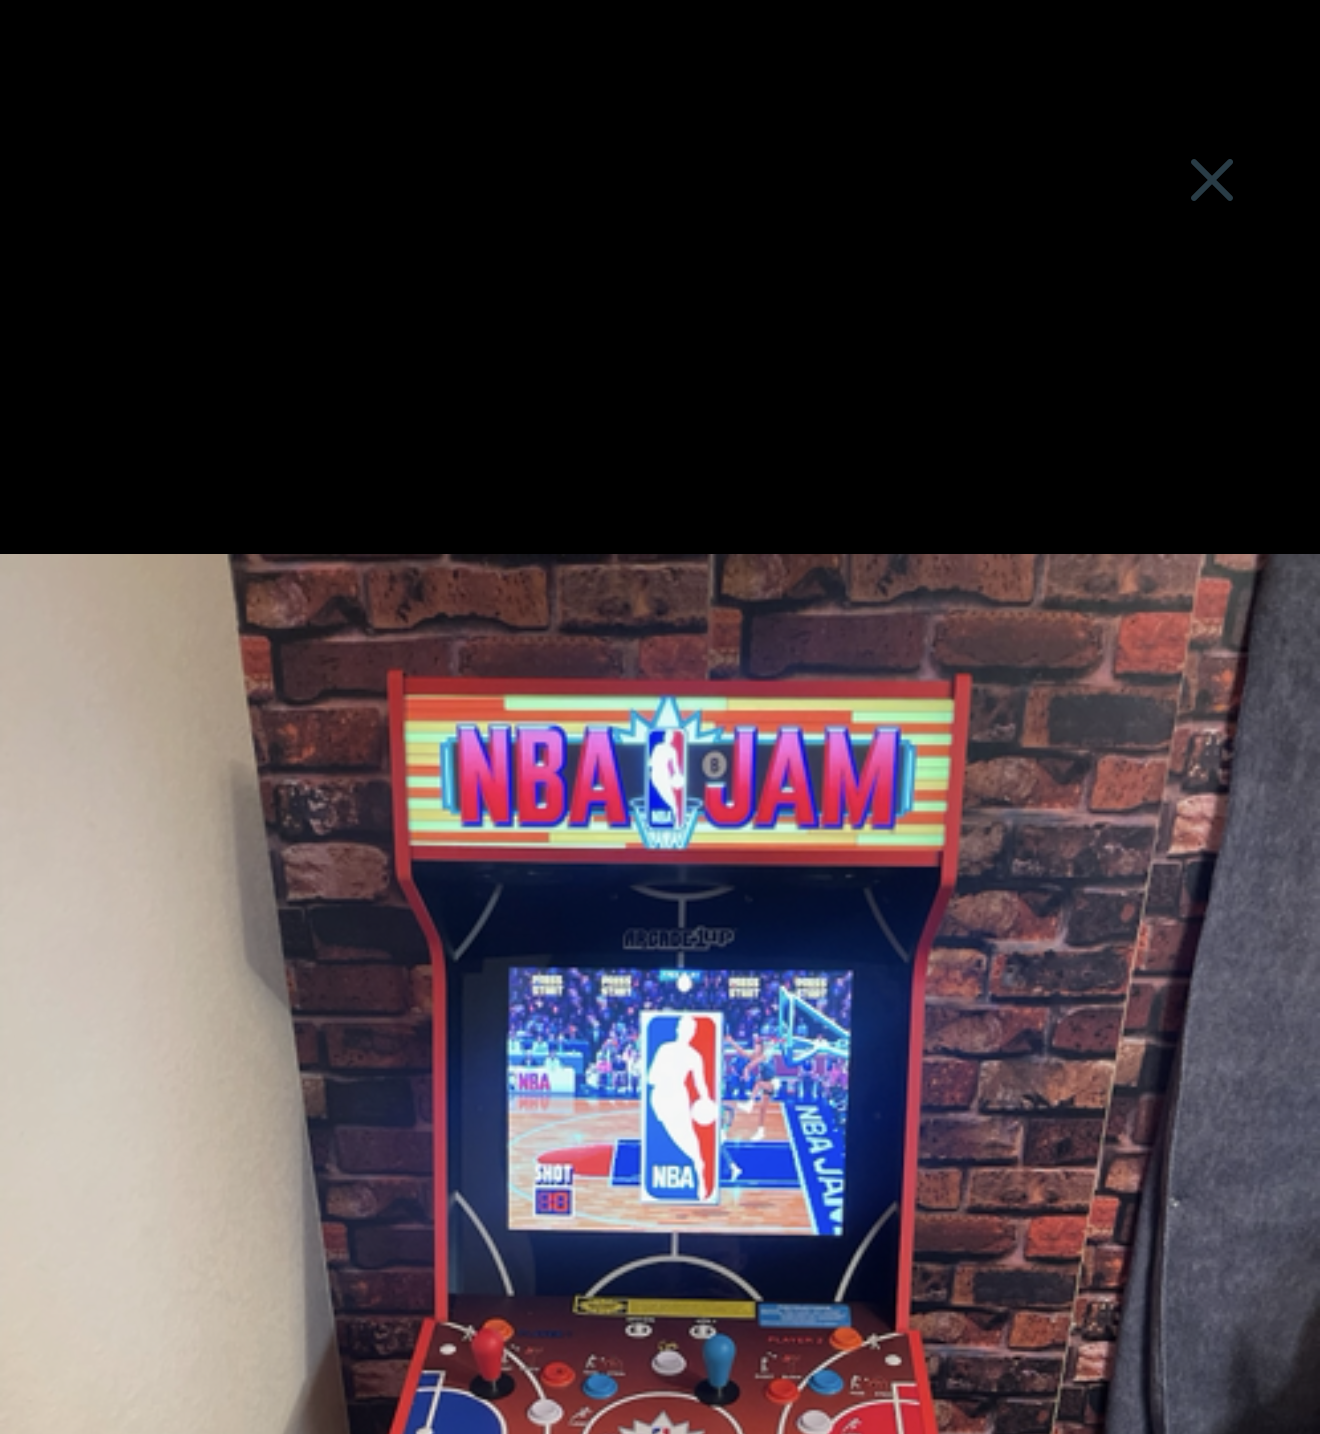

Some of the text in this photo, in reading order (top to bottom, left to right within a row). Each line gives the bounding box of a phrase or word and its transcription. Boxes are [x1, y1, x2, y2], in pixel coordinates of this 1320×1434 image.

[456, 724, 902, 831] NBA JAM
[518, 1072, 551, 1091] NBA
[796, 1105, 834, 1154] NBA
[535, 1164, 573, 1185] SHOT
[652, 1165, 695, 1189] NBA
